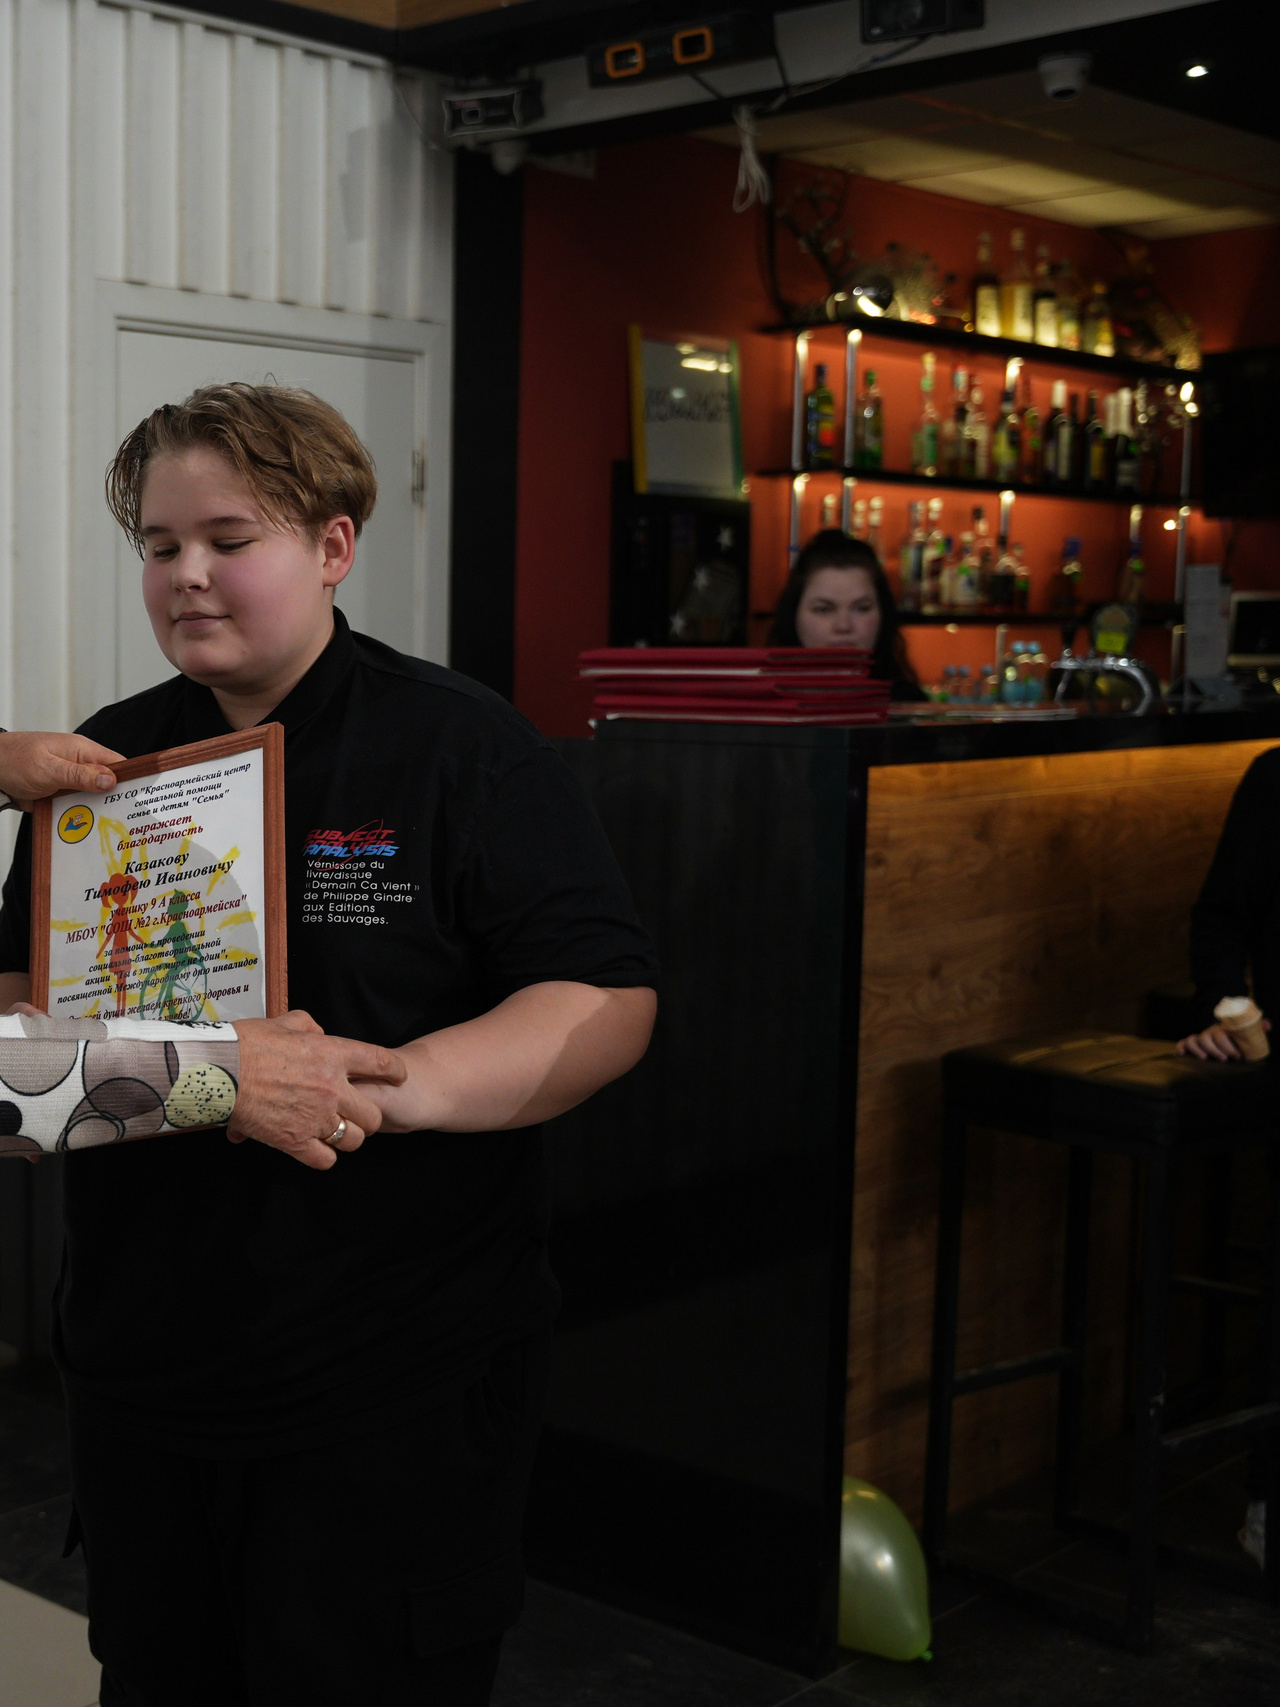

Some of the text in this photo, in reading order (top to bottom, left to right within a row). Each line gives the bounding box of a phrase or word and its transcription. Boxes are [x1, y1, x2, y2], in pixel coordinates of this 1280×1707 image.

[104, 763, 251, 804] ГБУ СО "Красноармейский центр
[134, 782, 222, 808] социальной помощи
[126, 810, 150, 820] семье
[160, 800, 189, 812] детям
[192, 789, 230, 805] "Семья"
[129, 814, 192, 836] выражает
[116, 826, 204, 852] благодарность
[302, 844, 400, 858] ANALYSIS
[124, 852, 190, 875] Казакову
[306, 870, 372, 880] livre/disque
[307, 860, 384, 870] Vernissage du
[84, 860, 234, 902] Тимофею Ивановичу
[360, 880, 378, 890] Ca
[382, 882, 411, 891] Vient
[109, 902, 148, 922] ученику
[150, 897, 156, 910] 9
[168, 890, 201, 906] класса
[302, 902, 375, 912] aux Editions
[304, 892, 412, 902] de Philippe Gindre
[302, 913, 388, 926] des Sauvages.
[65, 926, 98, 944] МБОУ
[104, 950, 112, 958] за
[114, 942, 148, 954] помощь
[155, 930, 206, 948] проведении
[88, 938, 222, 973] социально-благотворительной
[57, 957, 258, 1004] посвященной Международному дню инвалидов
[85, 975, 110, 986] акции
[114, 970, 130, 980] "Ты
[138, 964, 163, 976] этом
[164, 961, 184, 971] мире
[127, 1003, 162, 1015] желаем
[164, 993, 201, 1010] крепкого
[203, 986, 241, 1001] здоровья
[243, 984, 249, 992] и
